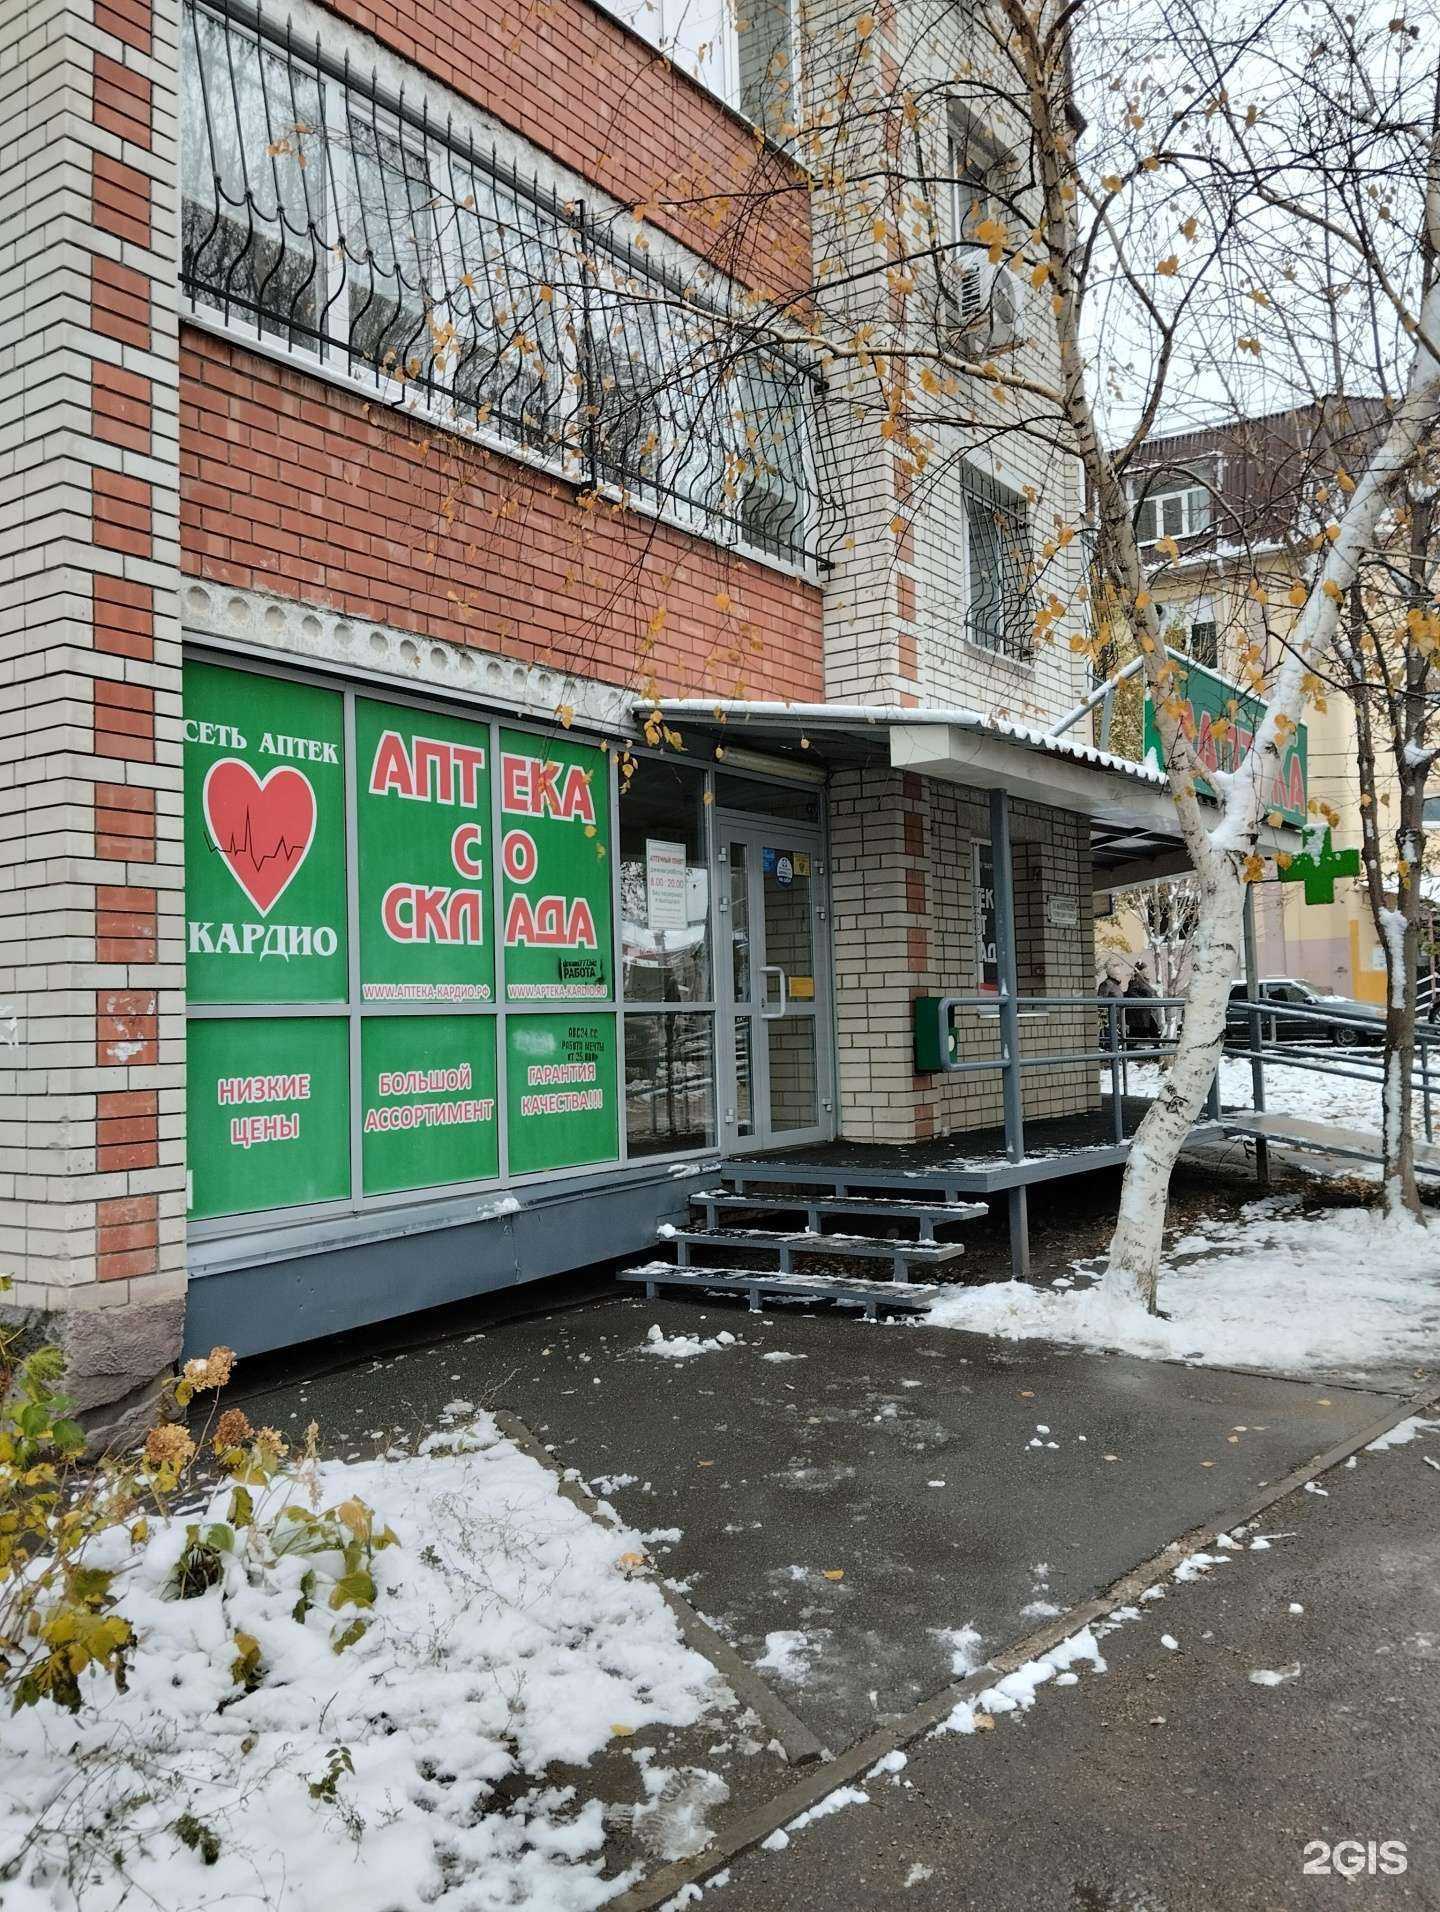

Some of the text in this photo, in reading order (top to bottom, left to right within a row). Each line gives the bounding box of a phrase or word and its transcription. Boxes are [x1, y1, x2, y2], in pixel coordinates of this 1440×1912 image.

[183, 719, 339, 764] СЕТЬ АПТЕК
[188, 921, 338, 962] КАРДИО
[563, 967, 596, 979] РАБОТА
[362, 984, 490, 1001] WWW.АПТЕКА-КАРДИО.РФ
[218, 1073, 310, 1105] НИЗКИЕ
[379, 1062, 472, 1097] БОЛЬШОЙ
[527, 1062, 597, 1086] ГАРАНТИЯ
[364, 1099, 495, 1133] АССОРТИМЕНТ
[521, 1088, 603, 1116] КАЧЕСТВА!!!
[231, 1113, 299, 1149] ЦЕНЫ
